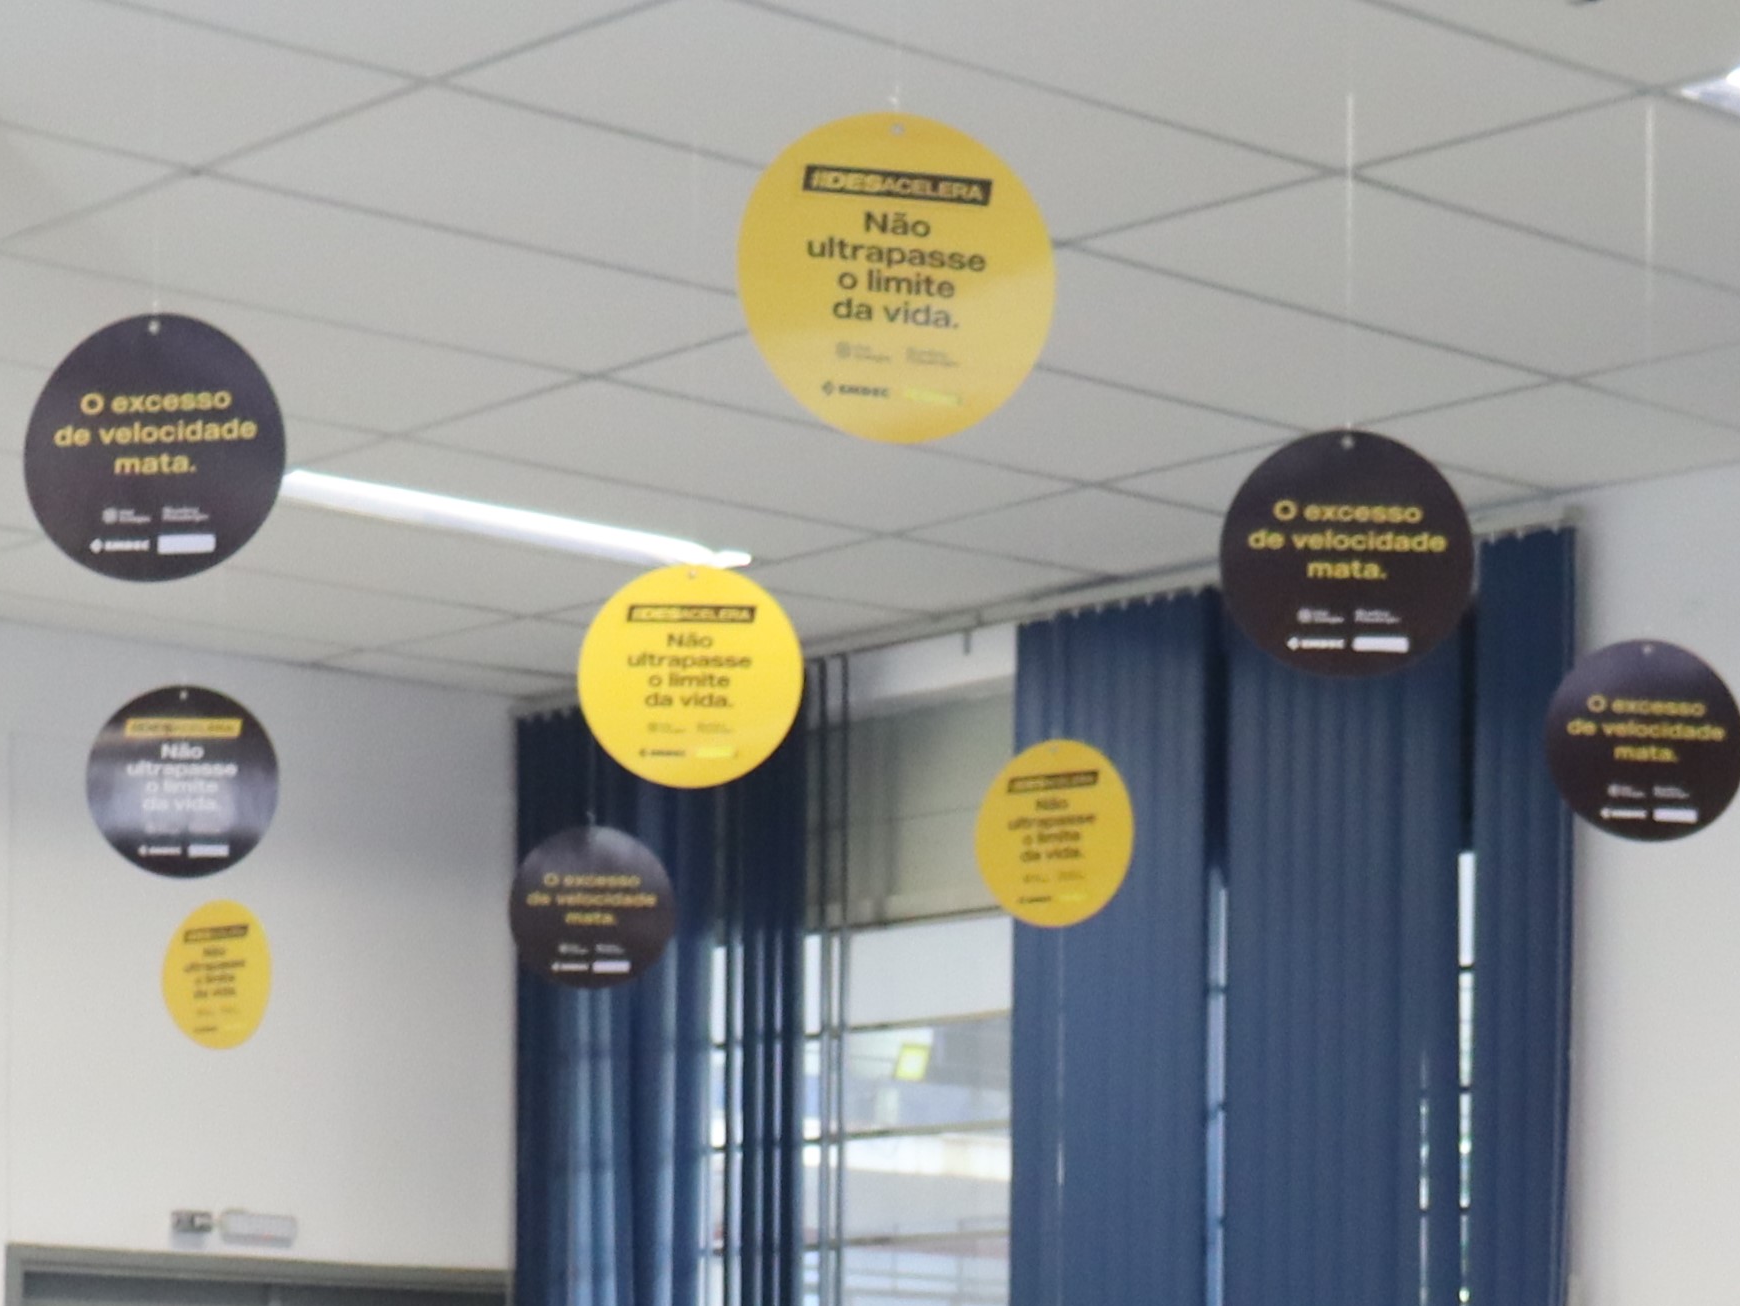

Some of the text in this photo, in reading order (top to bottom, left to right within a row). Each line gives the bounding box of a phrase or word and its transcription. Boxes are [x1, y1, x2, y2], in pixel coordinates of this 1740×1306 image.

[812, 169, 984, 202] #DESACELERA
[864, 211, 931, 238] Não
[807, 236, 987, 272] ultrapasse
[837, 269, 956, 299] o limite
[832, 298, 960, 330] da vida.
[80, 390, 233, 415] O excesso
[53, 418, 258, 447] de velocidade
[113, 453, 197, 475] mata.
[1273, 500, 1423, 523] O excesso
[1248, 529, 1448, 553] de velocidade
[1307, 560, 1387, 580] mata.
[666, 632, 713, 648] Não
[627, 653, 752, 670] ultrapasse
[649, 673, 731, 688] o limite
[644, 692, 734, 708] da vida.
[1586, 694, 1607, 713] O
[543, 873, 559, 888] O
